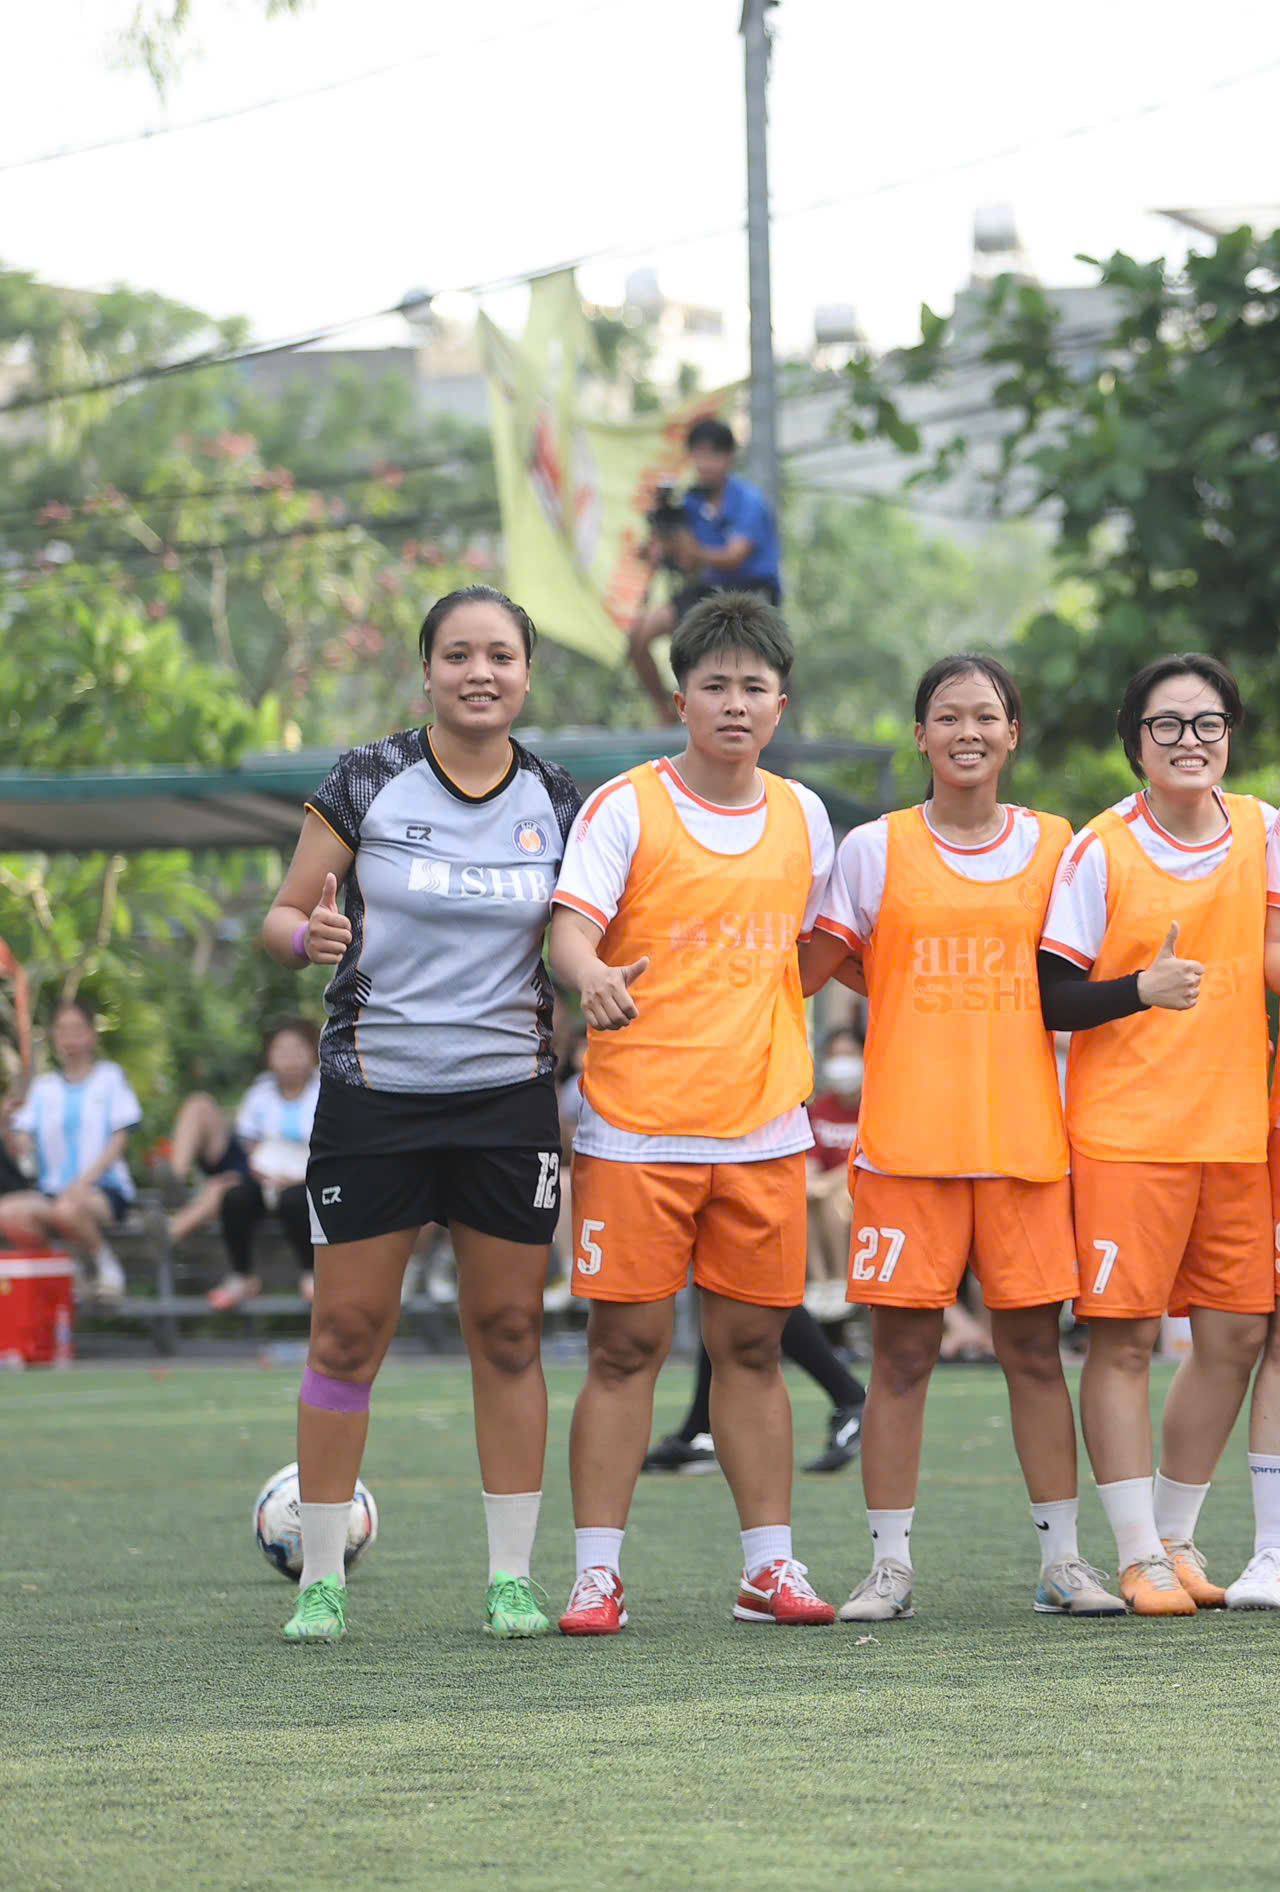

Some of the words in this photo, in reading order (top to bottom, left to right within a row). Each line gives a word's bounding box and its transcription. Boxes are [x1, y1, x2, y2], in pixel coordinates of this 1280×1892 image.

[461, 866, 550, 903] SHB
[533, 1152, 560, 1209] 12
[577, 1219, 606, 1276] 5
[852, 1226, 907, 1283] 27
[1092, 1239, 1120, 1295] 7
